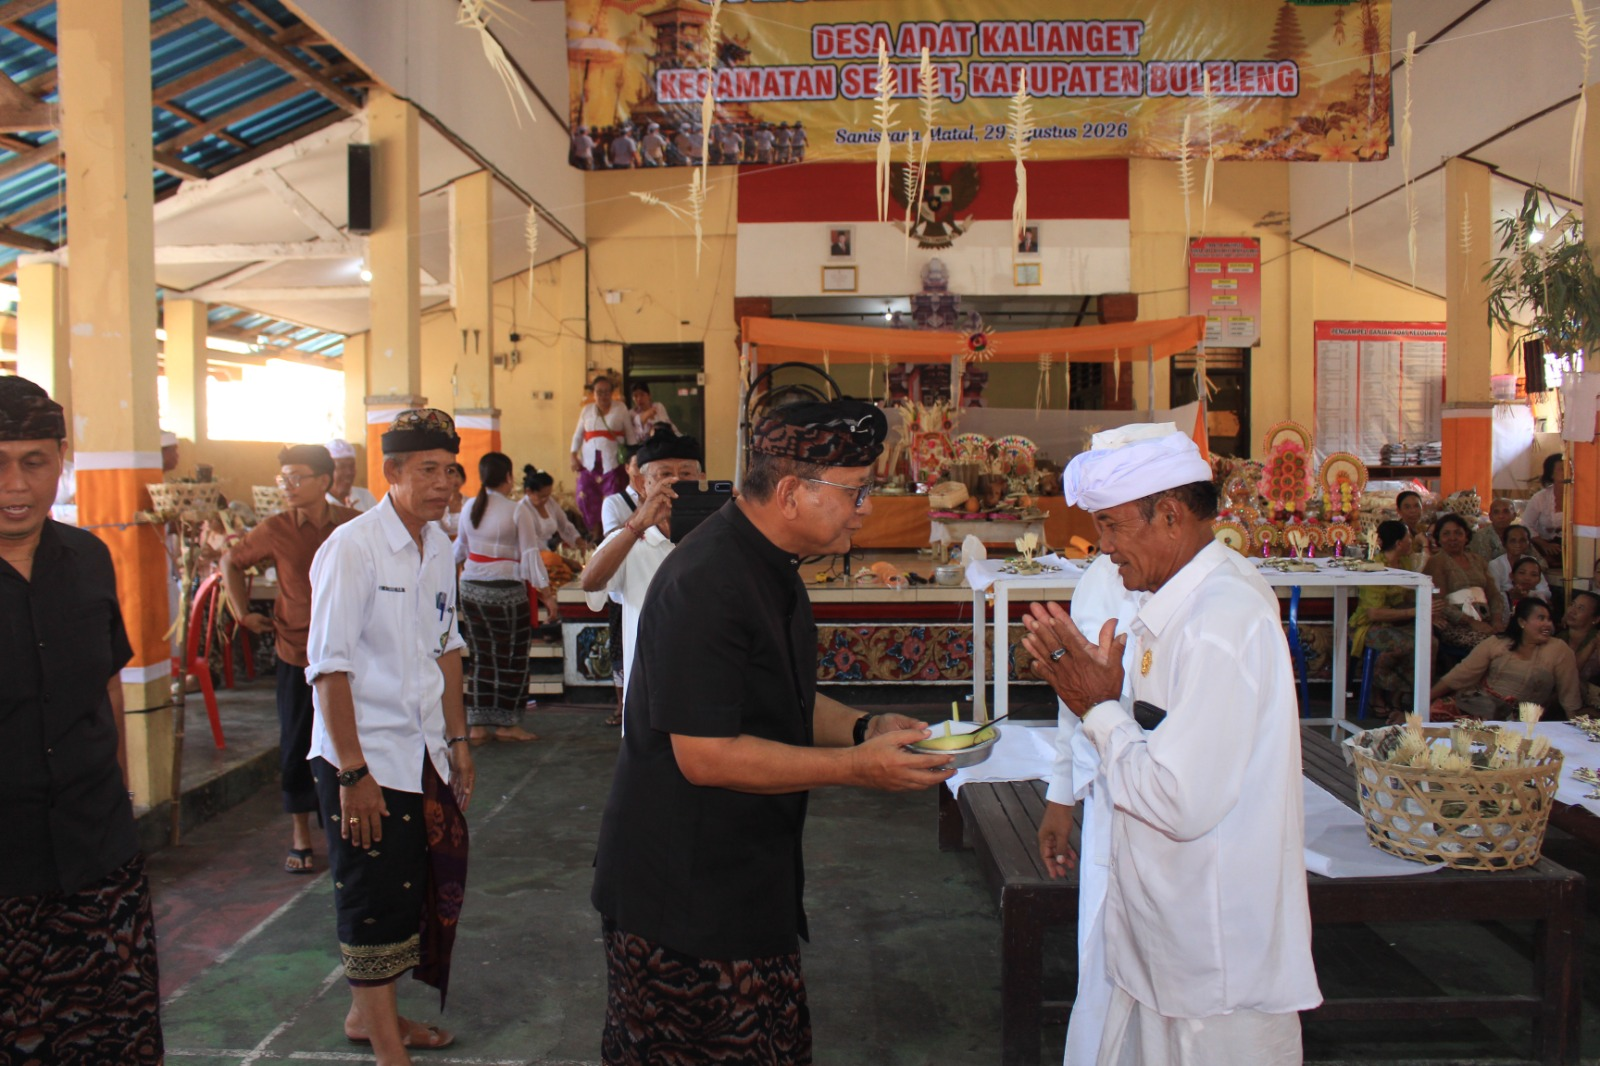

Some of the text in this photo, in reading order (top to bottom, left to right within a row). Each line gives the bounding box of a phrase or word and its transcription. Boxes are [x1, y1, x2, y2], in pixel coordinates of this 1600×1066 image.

[815, 24, 1141, 57] DESA ADAT KALIANGET
[659, 67, 833, 100] KECAMATAN
[971, 64, 1140, 95] KABUPATEN
[1149, 64, 1296, 94] BULELENG
[835, 127, 921, 145] Sanisara
[983, 124, 1007, 140] 29
[1009, 124, 1078, 142] ustus
[1082, 122, 1128, 139] 2026
